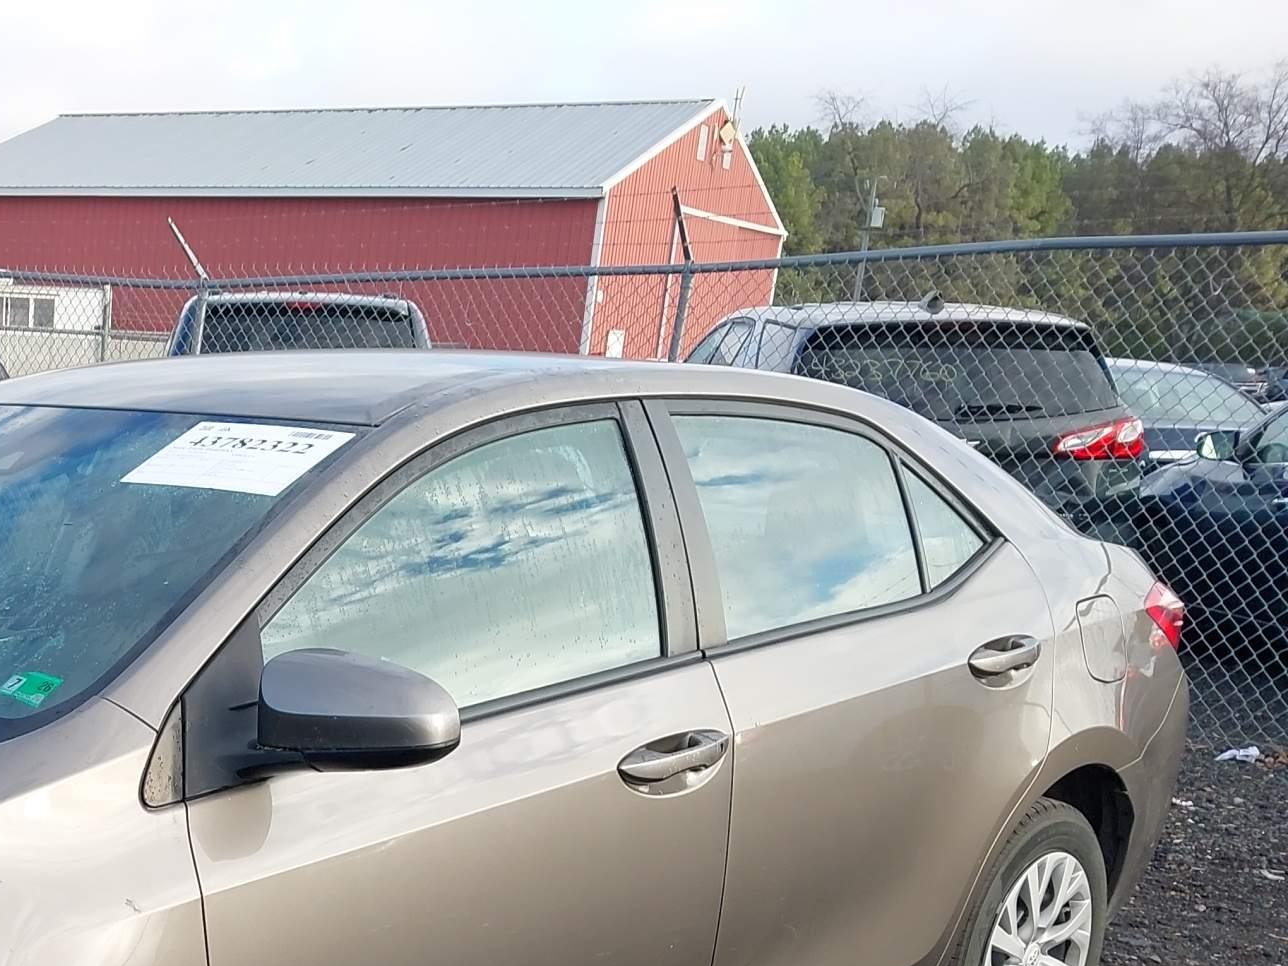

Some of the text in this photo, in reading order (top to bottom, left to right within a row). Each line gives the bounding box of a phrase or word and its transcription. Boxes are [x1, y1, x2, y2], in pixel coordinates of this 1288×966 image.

[188, 434, 315, 455] 43782322
[7, 678, 23, 689] 7
[37, 680, 54, 693] 26
